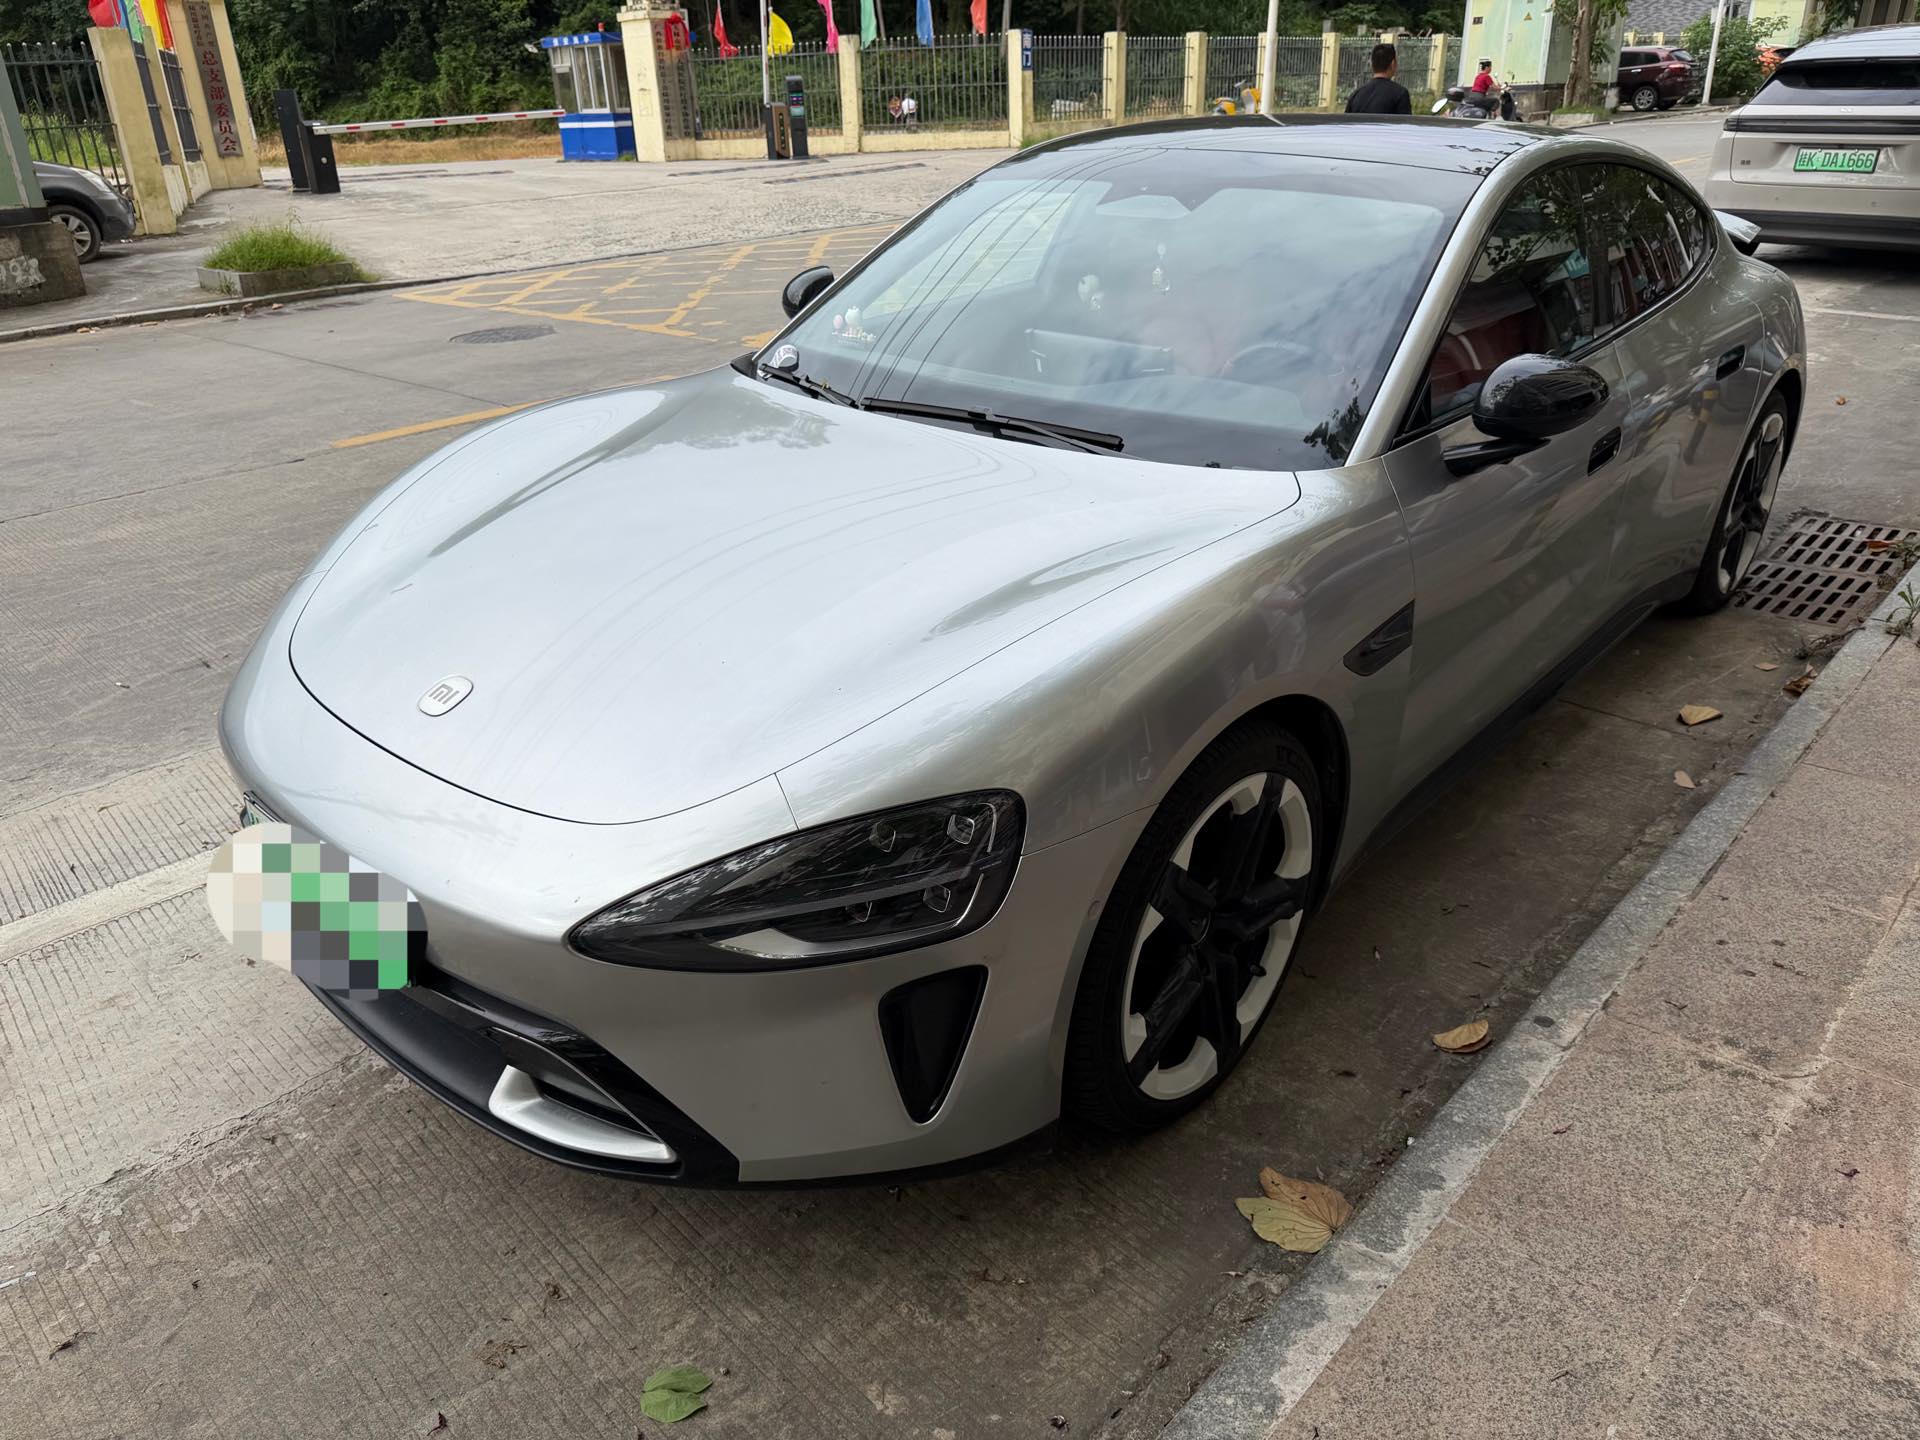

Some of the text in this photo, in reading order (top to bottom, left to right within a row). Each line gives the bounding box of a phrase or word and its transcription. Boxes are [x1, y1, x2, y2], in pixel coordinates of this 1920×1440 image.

[202, 50, 237, 152] 总支部委员会
[1821, 151, 1875, 169] DA1666
